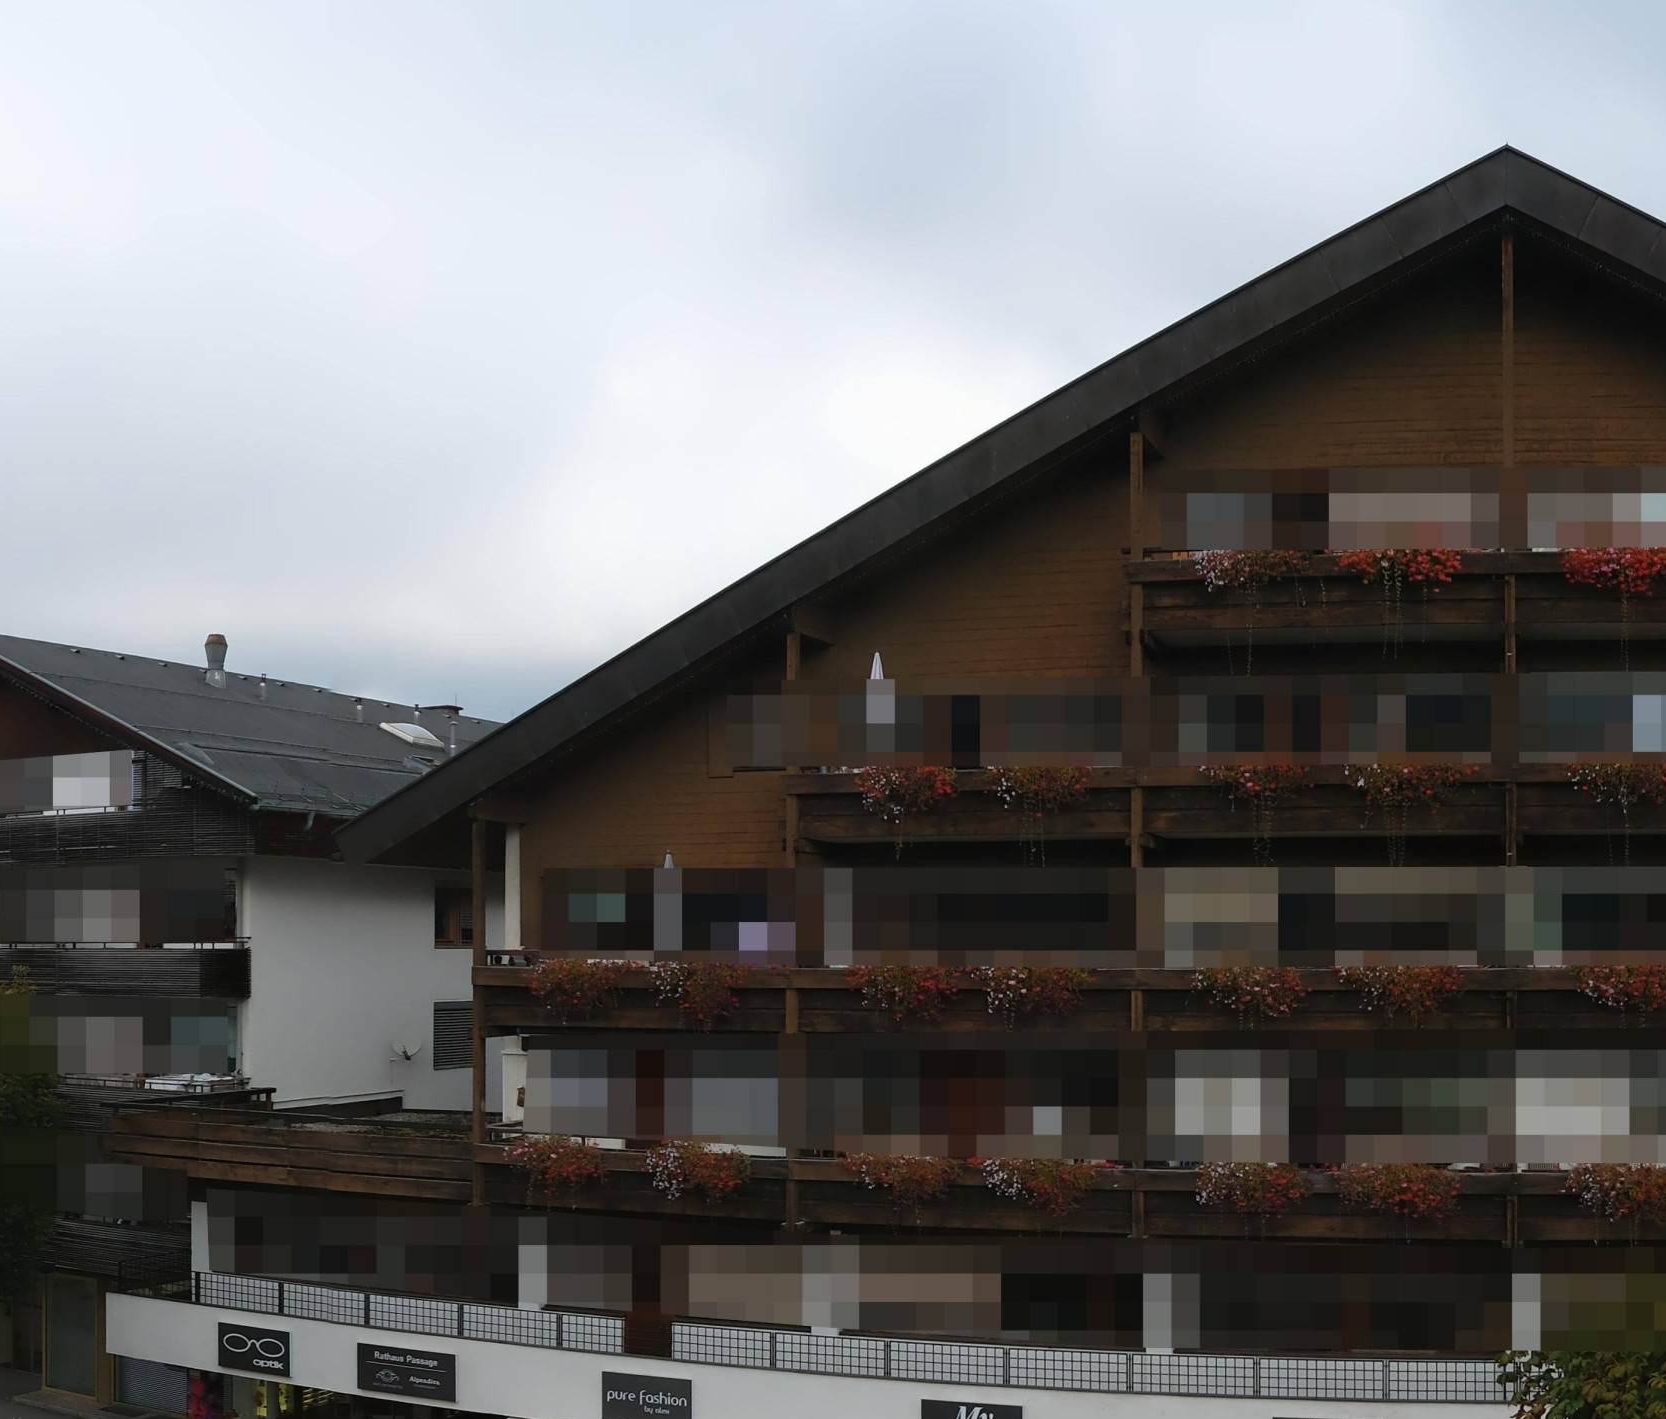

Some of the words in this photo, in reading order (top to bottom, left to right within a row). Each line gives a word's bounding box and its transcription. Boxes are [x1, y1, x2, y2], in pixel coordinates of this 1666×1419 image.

[253, 1358, 284, 1370] optik
[374, 1351, 404, 1362] Rathaus
[406, 1355, 438, 1368] Passage
[606, 1389, 636, 1402] pure
[639, 1389, 687, 1407] fashion
[643, 1405, 653, 1415] by
[655, 1406, 670, 1415] alex
